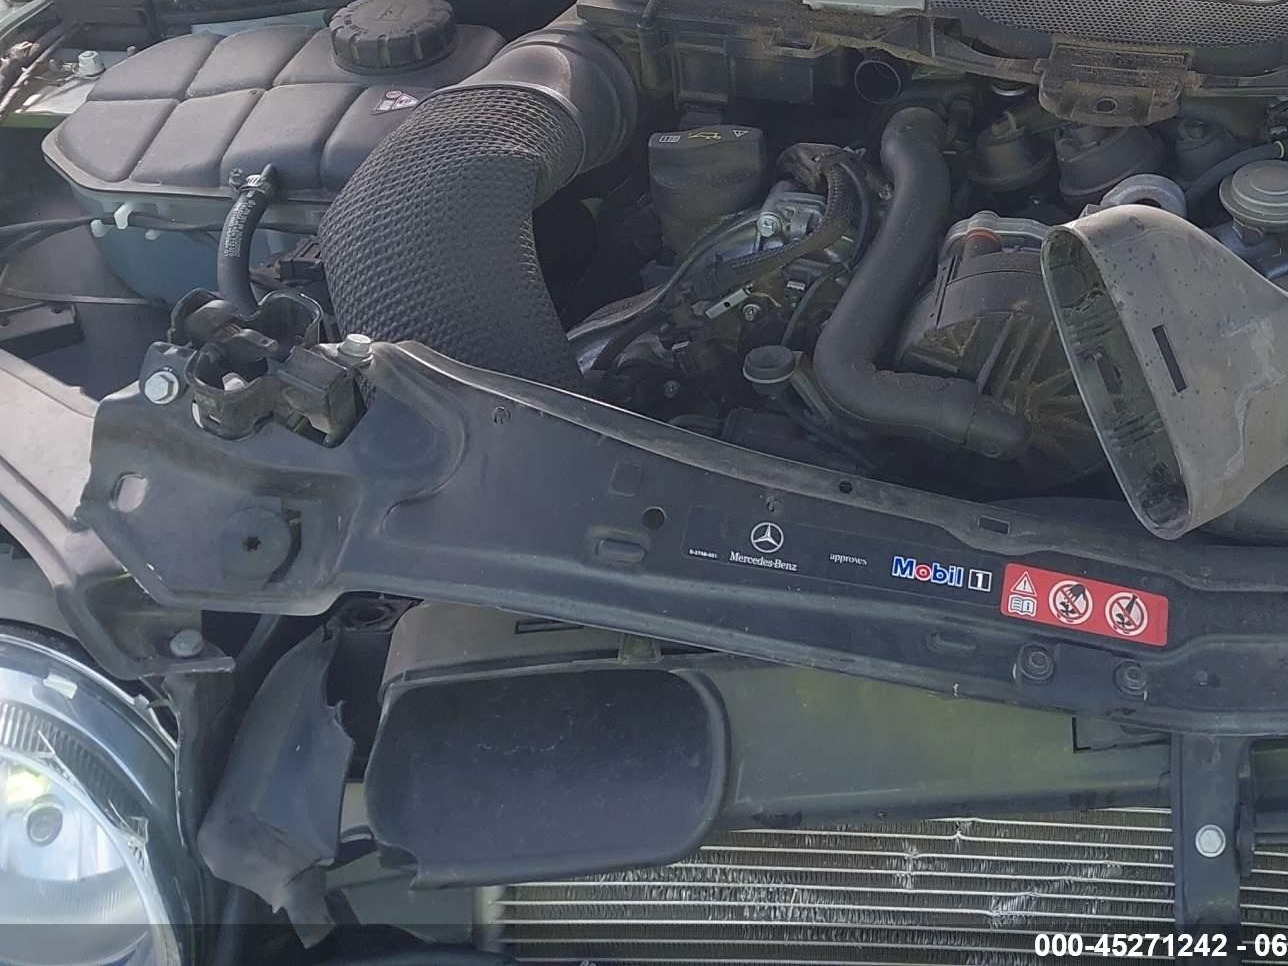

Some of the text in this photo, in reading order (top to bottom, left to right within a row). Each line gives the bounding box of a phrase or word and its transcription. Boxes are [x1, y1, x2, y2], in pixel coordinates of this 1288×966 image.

[729, 551, 798, 571] Mercedes-Benz
[829, 553, 867, 566] approves
[892, 555, 965, 587] Mobil
